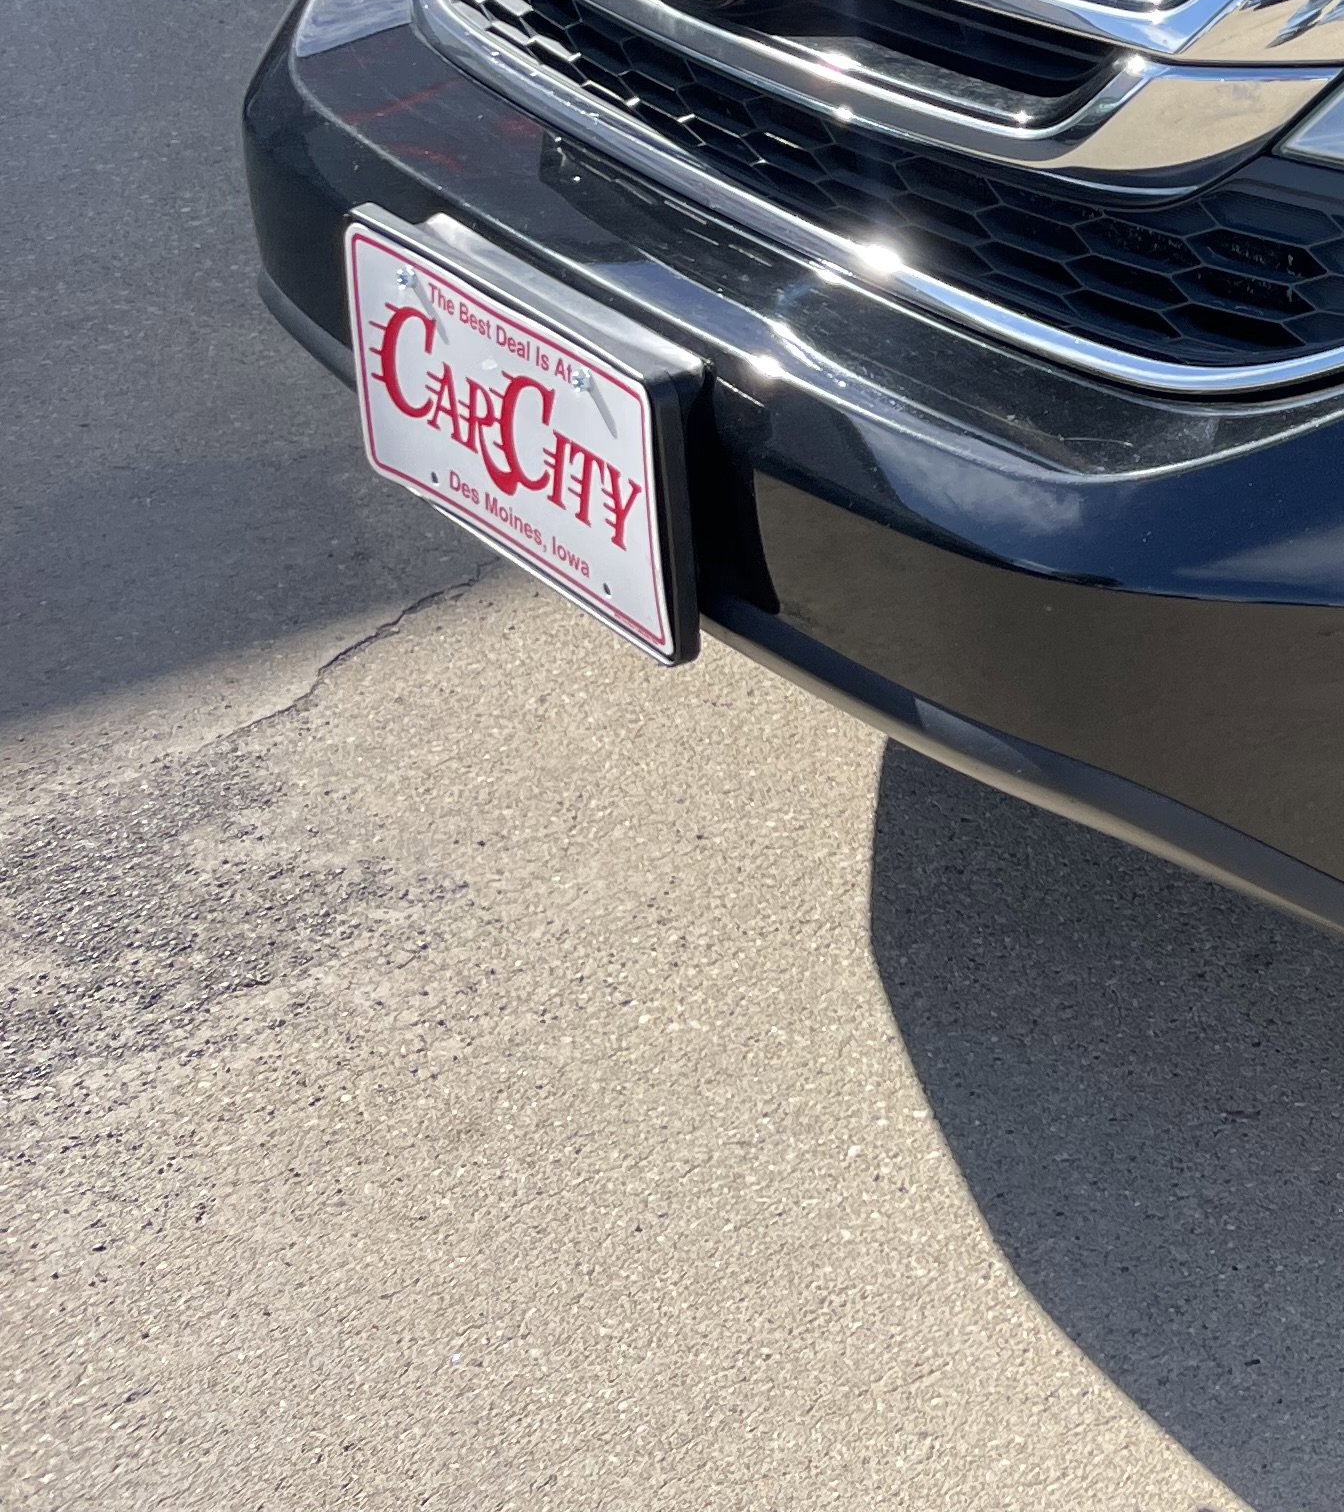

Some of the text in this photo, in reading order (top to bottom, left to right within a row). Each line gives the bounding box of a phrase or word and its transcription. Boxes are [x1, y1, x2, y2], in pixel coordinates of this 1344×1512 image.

[428, 281, 456, 317] The
[458, 300, 493, 340] Best
[495, 324, 531, 363] Deal
[535, 345, 550, 372] Is
[448, 470, 591, 580] Des Moines, Iowa
